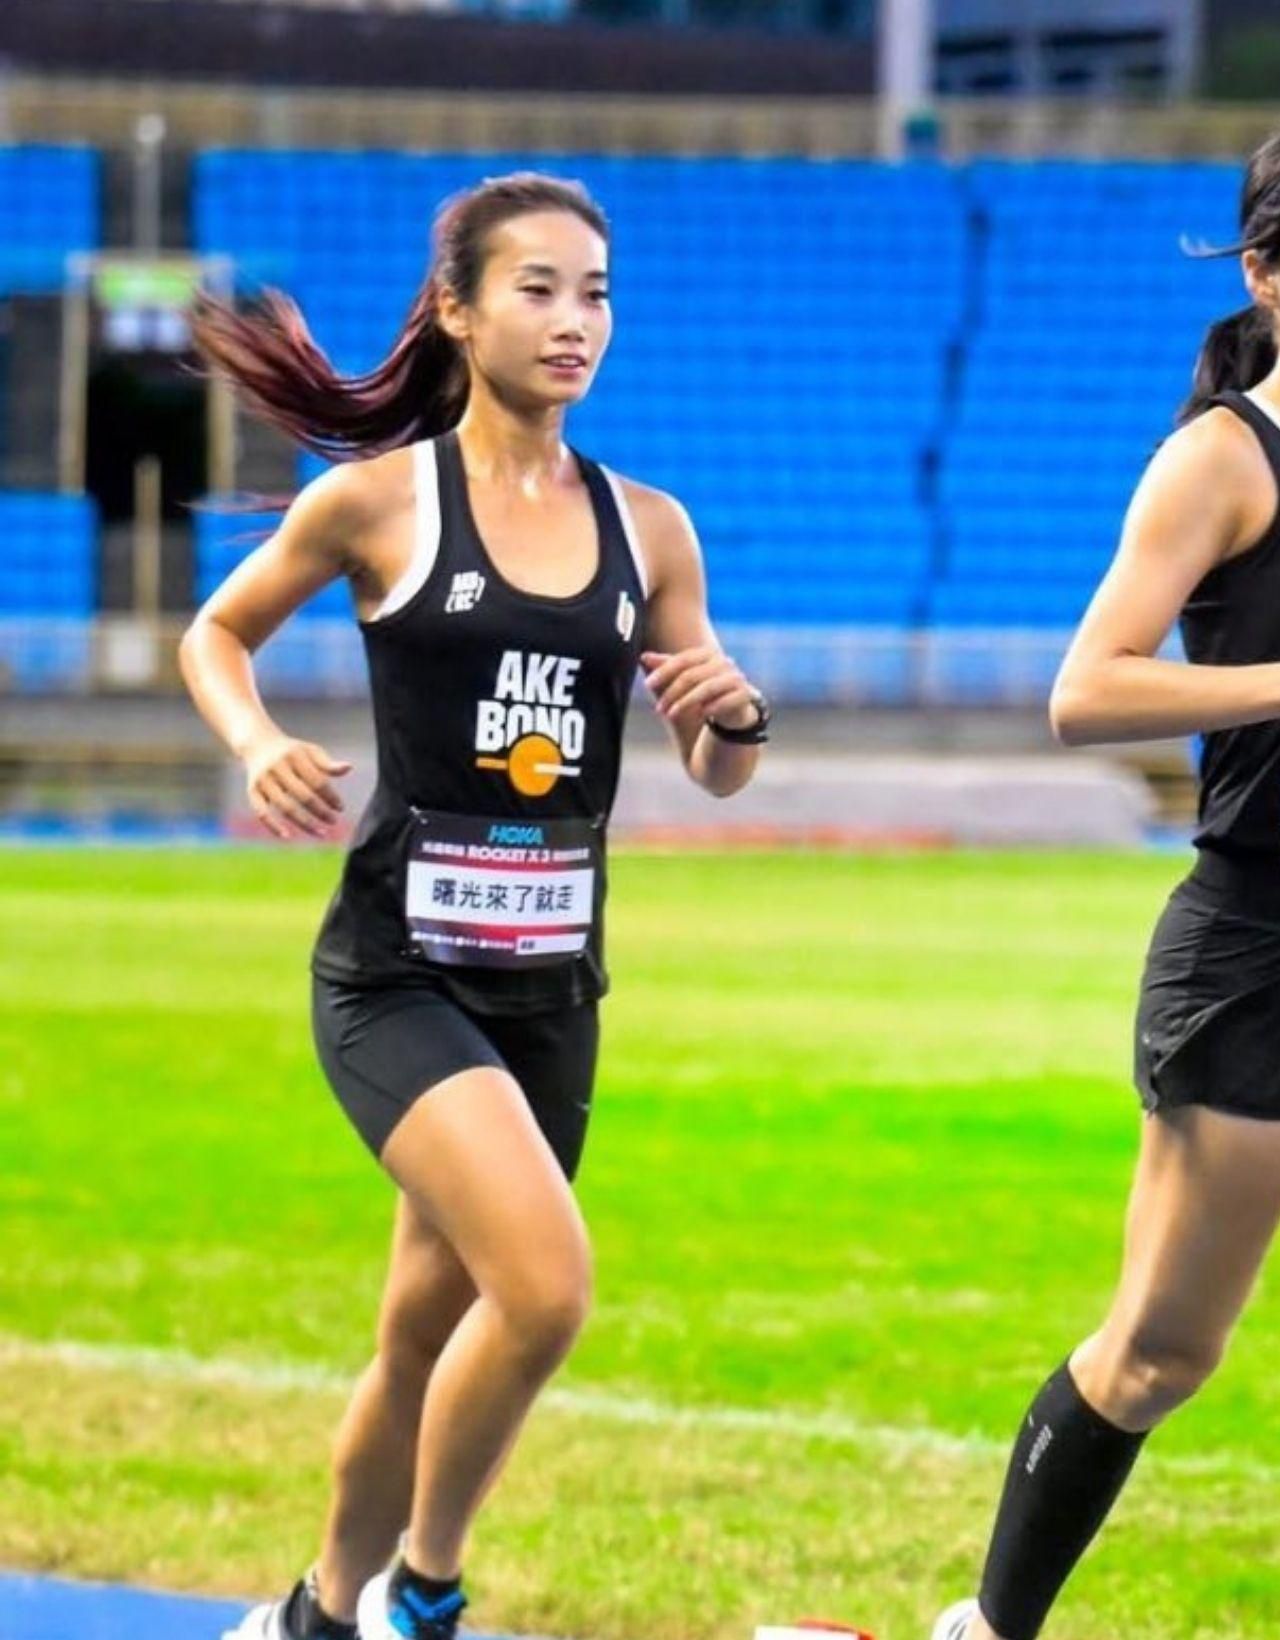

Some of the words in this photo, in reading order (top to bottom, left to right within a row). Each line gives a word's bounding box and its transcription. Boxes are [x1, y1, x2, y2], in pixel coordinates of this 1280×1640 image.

[494, 650, 581, 707] AKE
[475, 700, 586, 760] BONO
[488, 825, 544, 845] HOKA
[432, 877, 573, 913] 曙光來了就走
